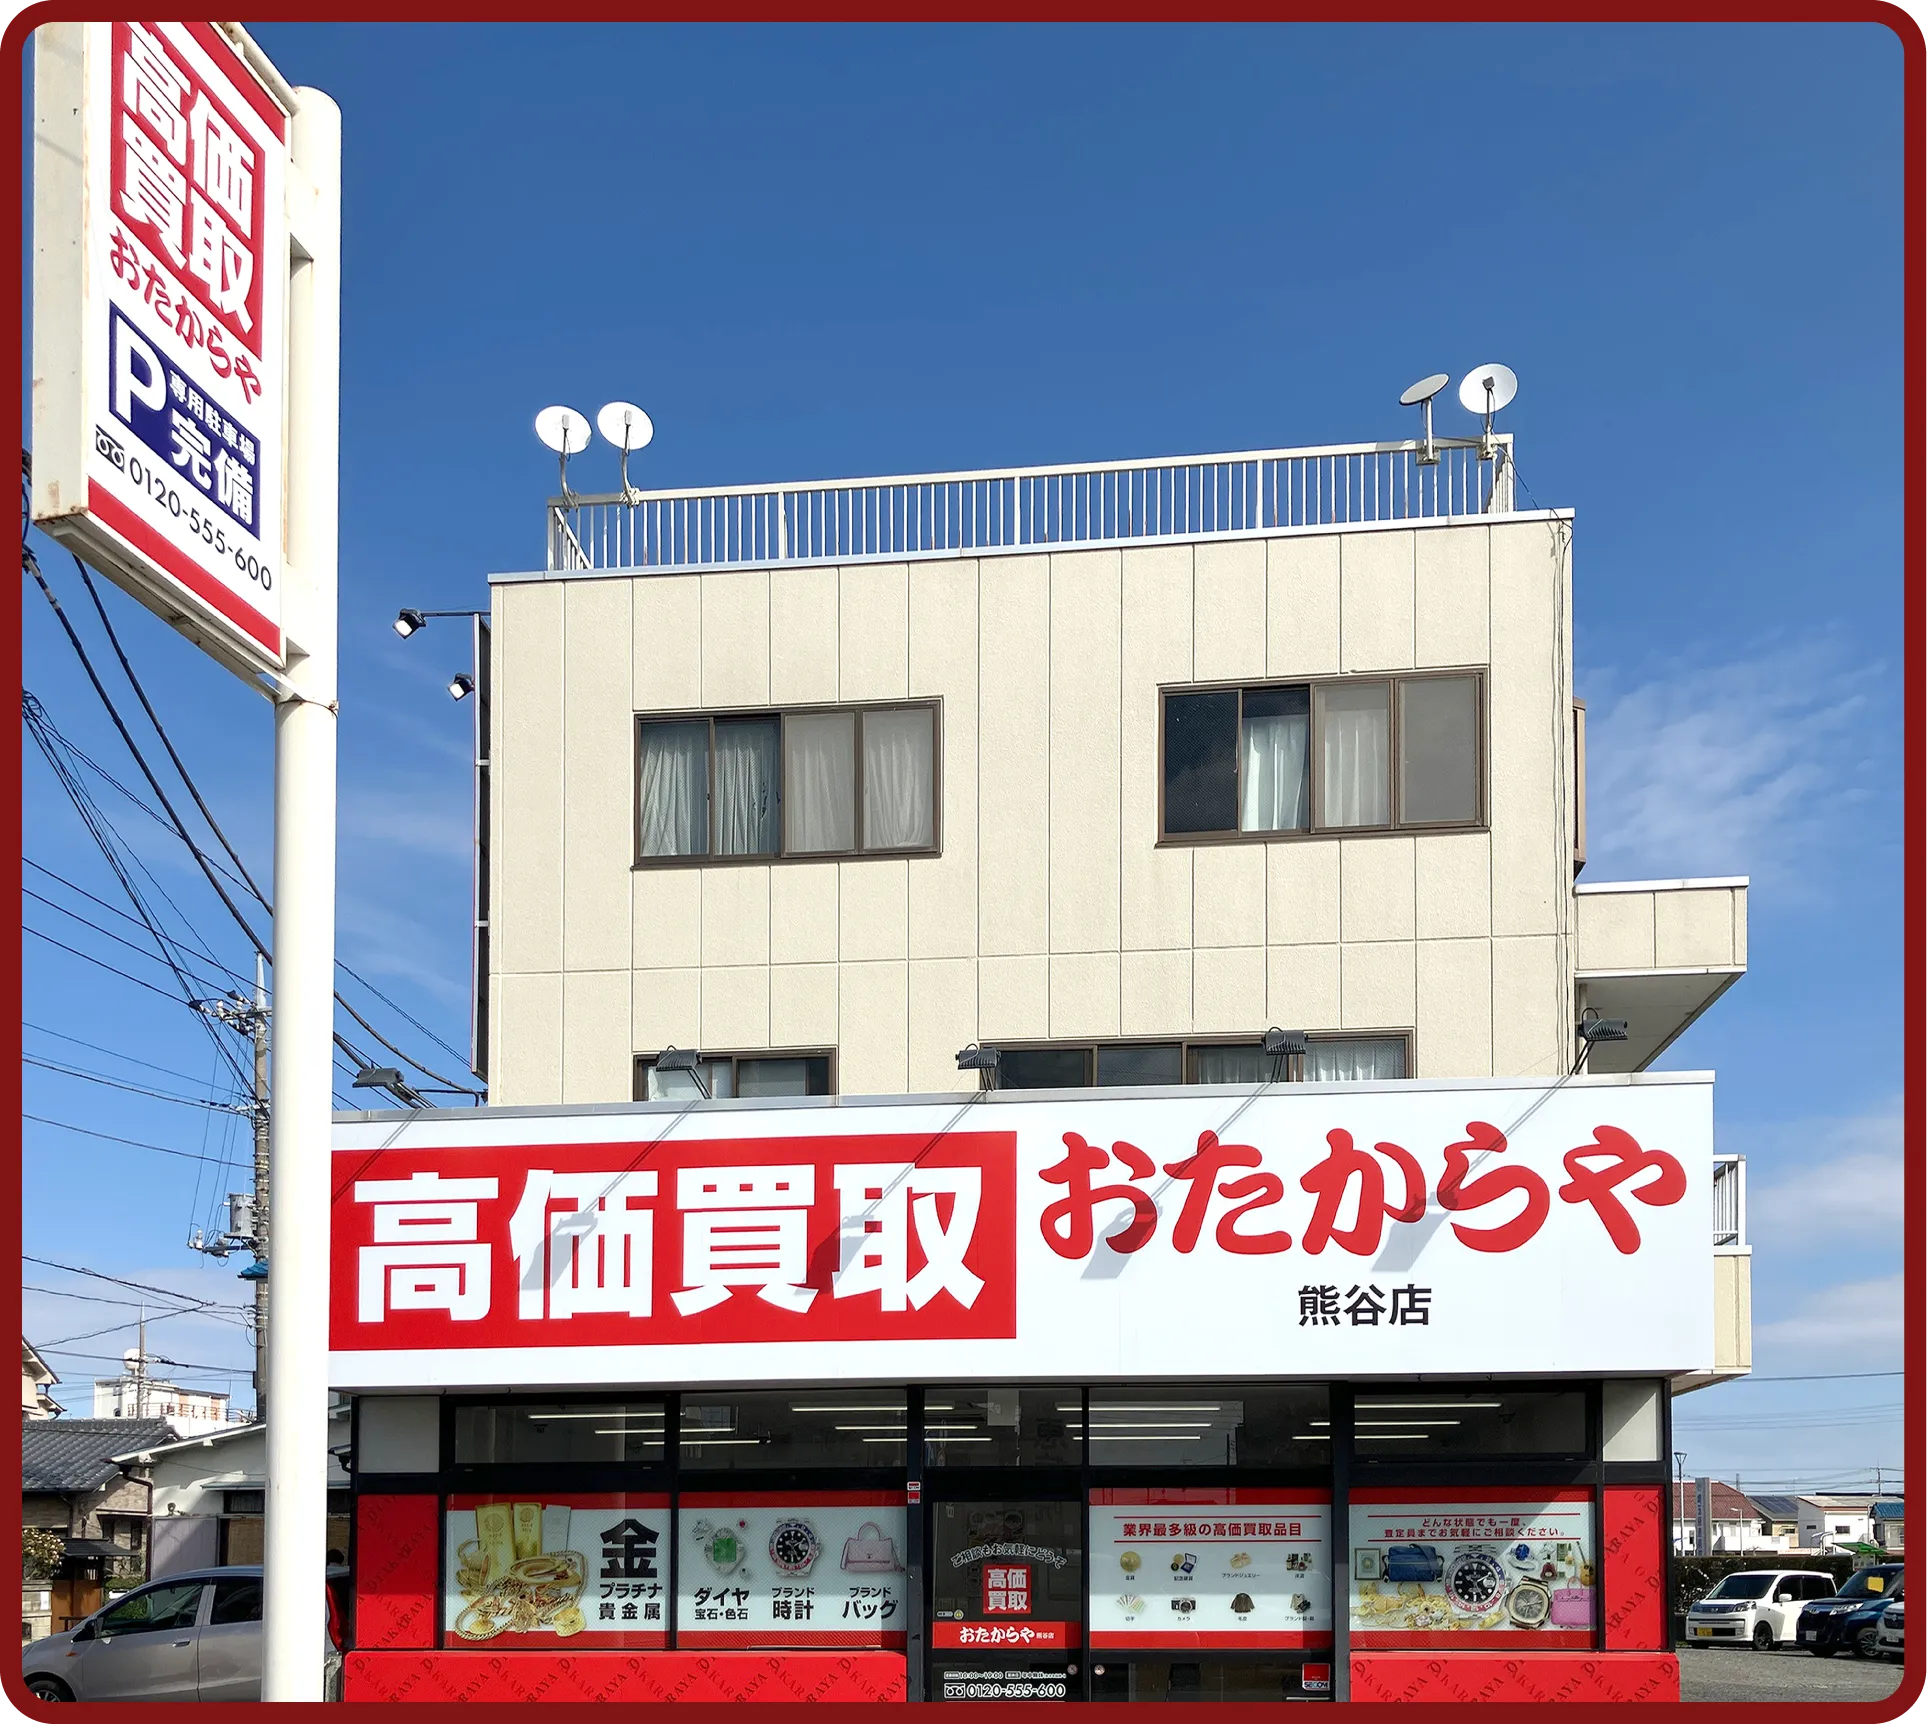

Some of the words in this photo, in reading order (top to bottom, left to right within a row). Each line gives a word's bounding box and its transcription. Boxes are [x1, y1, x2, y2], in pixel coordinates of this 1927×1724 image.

[119, 111, 254, 335] 買取
[109, 226, 263, 404] おたからや
[116, 312, 167, 425] P
[169, 369, 257, 467] 専用駐車場
[170, 411, 255, 527] 完備
[129, 460, 273, 591] 0120-555-600
[353, 1162, 986, 1323] 高価買取
[1037, 1120, 1687, 1260] おたからや
[1297, 1283, 1433, 1327] 熊谷店
[1122, 1522, 1303, 1537] 業界最多級の高価買取品目
[599, 1518, 660, 1578] 金
[987, 1568, 1028, 1589] 高価
[599, 1582, 663, 1599] プラチナ
[693, 1587, 750, 1606] ダイヤ
[771, 1586, 815, 1598] ブランド
[849, 1586, 892, 1598] ブランド
[987, 1590, 1028, 1611] 買取
[598, 1602, 661, 1620] 貴金属
[694, 1608, 749, 1620] 宝石・色石
[772, 1599, 814, 1620] 時計
[841, 1599, 899, 1620] バッグ
[959, 1626, 1035, 1644] おたからや
[966, 1683, 1066, 1698] 0120-555-600
[1303, 1681, 1329, 1689] SECOM
